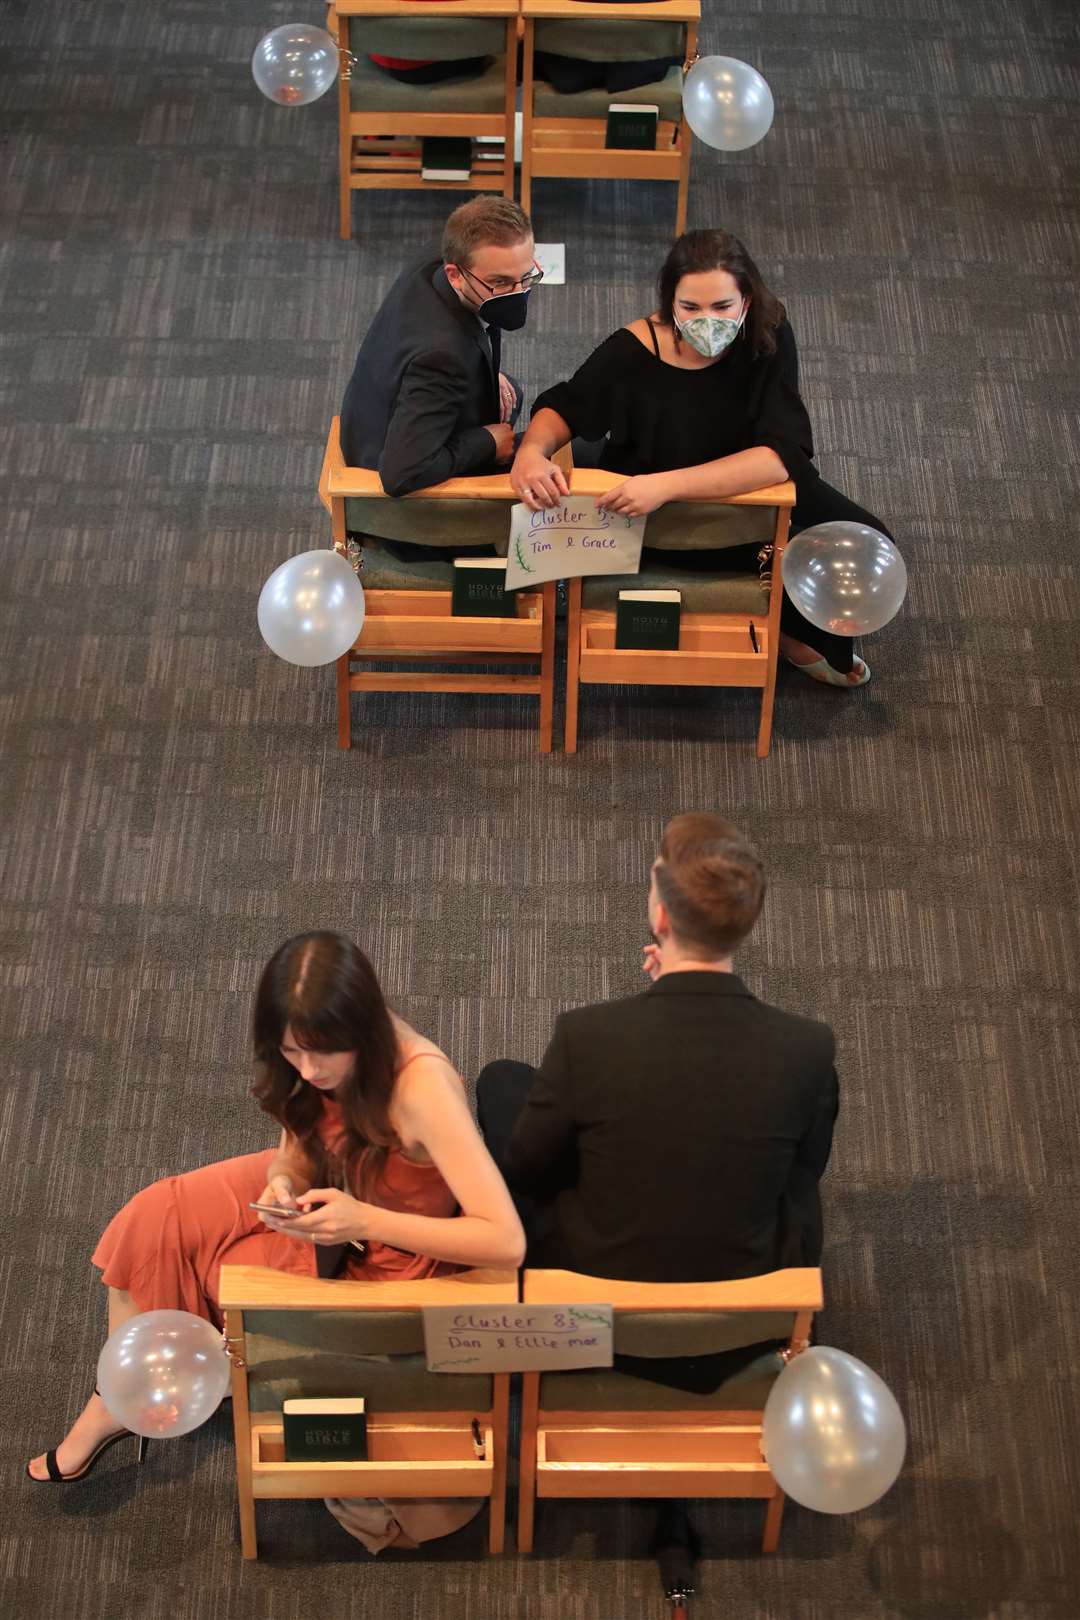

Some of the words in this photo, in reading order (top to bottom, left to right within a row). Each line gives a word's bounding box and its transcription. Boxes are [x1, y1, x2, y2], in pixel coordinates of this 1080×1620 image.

[530, 508, 587, 528] Cluster
[531, 542, 552, 554] Tim
[582, 536, 617, 549] Grace
[453, 1314, 537, 1328] Cluster
[448, 1336, 482, 1349] Dan
[514, 1335, 560, 1349] Ellie
